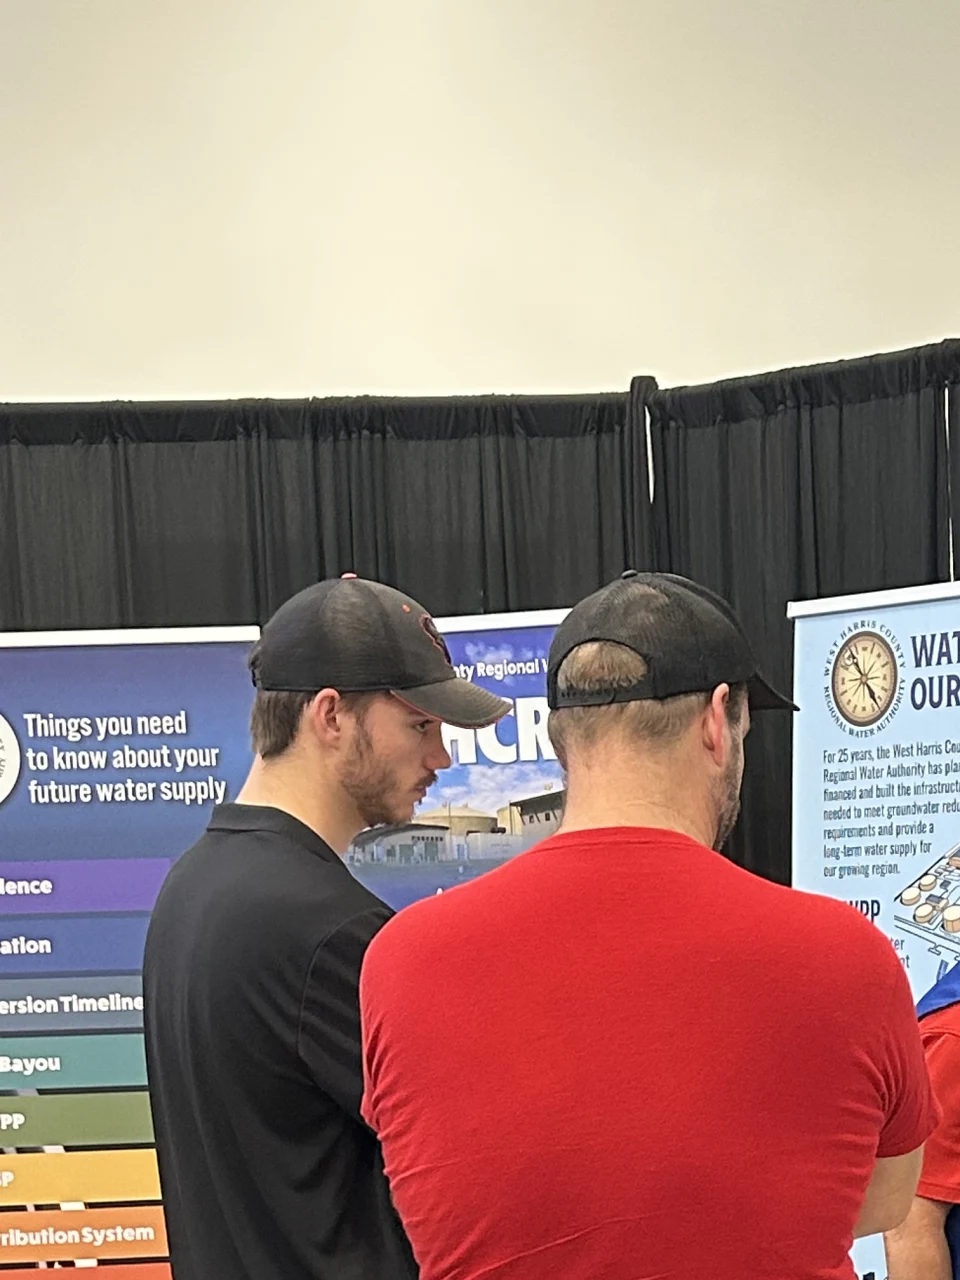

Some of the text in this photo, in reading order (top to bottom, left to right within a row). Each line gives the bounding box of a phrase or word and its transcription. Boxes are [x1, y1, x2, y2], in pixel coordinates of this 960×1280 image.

[824, 620, 906, 677] WEST HARRIS COUNTY
[476, 659, 540, 680] Regional
[876, 678, 906, 733] AUTHORITY
[23, 711, 187, 742] Things you need
[26, 748, 48, 771] to
[53, 747, 107, 769] know
[112, 745, 171, 768] about
[176, 748, 219, 773] your
[823, 750, 836, 763] For
[838, 748, 849, 762] 25
[850, 750, 874, 764] years,
[877, 746, 890, 760] the
[893, 744, 914, 758] West
[916, 741, 942, 757] Harris
[823, 767, 857, 784] Regional
[859, 766, 884, 780] Water
[886, 763, 926, 779] Authority
[928, 761, 942, 775] has
[28, 776, 226, 805] future water supply
[823, 787, 857, 801] financed
[859, 785, 873, 800] and
[875, 783, 895, 799] built
[897, 782, 911, 797] the
[823, 806, 851, 821] needed
[853, 807, 862, 819] to
[864, 804, 885, 818] meet
[887, 802, 939, 819] groundwater
[823, 820, 935, 841] requirements and provide a
[823, 840, 932, 860] long-term water supply for
[823, 861, 900, 879] our growing region.
[59, 993, 144, 1013] Timeline
[0, 1056, 61, 1075] Bayou
[82, 1226, 155, 1246] System
